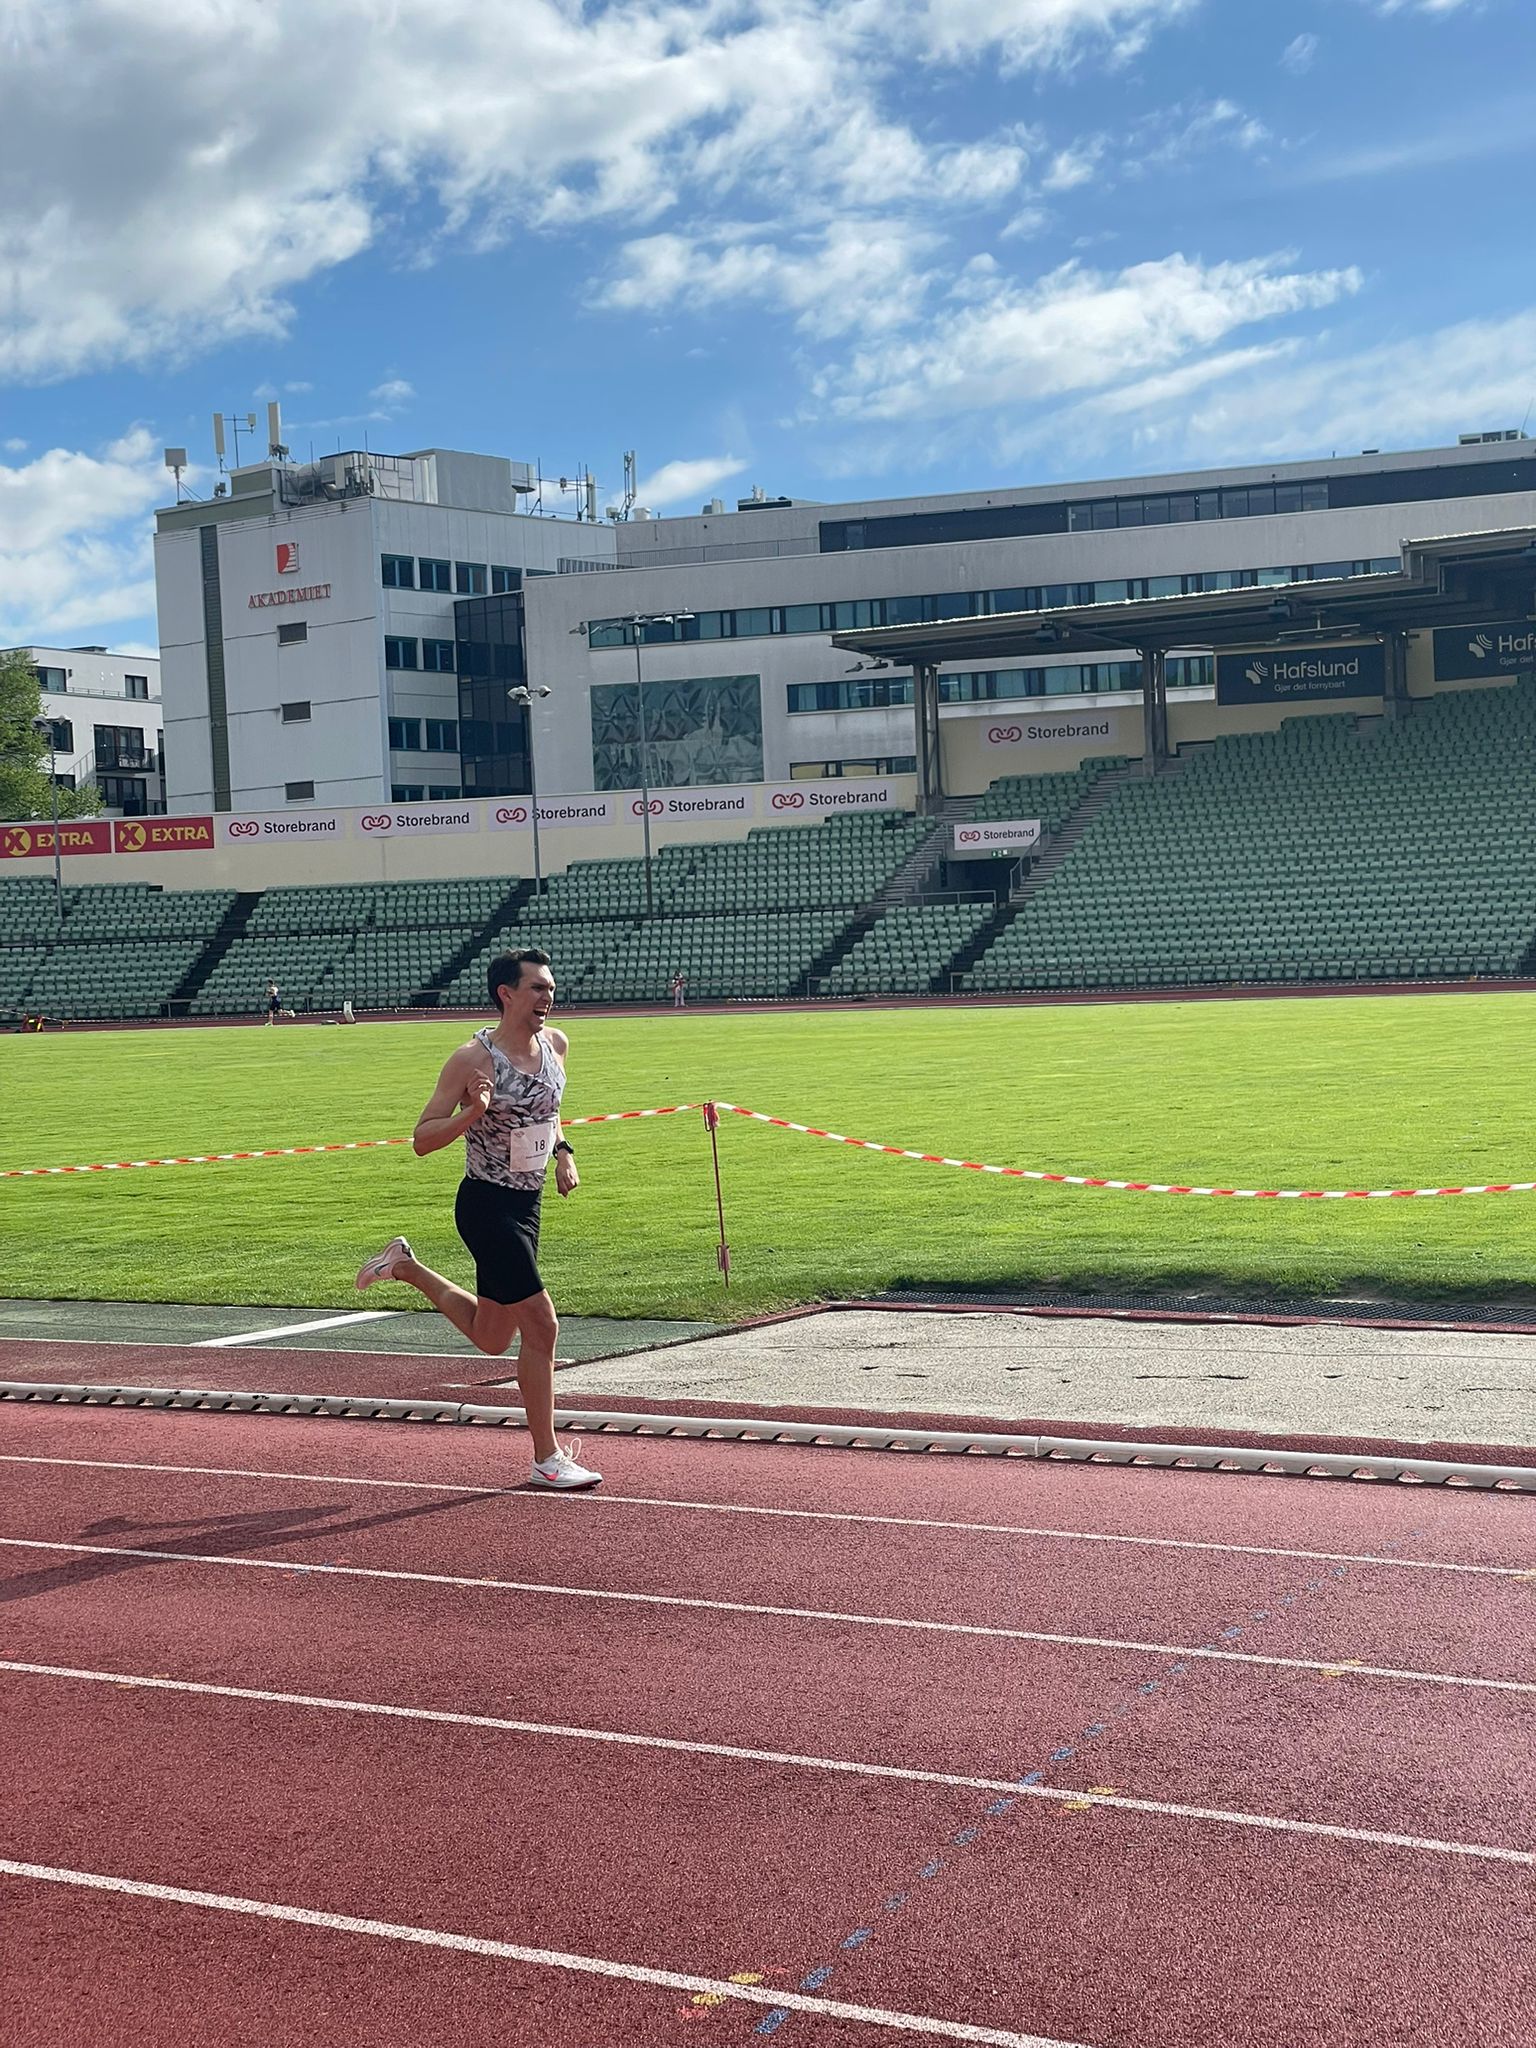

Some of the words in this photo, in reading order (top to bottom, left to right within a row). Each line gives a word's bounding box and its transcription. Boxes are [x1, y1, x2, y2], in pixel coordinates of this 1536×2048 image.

[248, 583, 331, 608] AKADEMIET
[1499, 633, 1536, 652] Haf
[1273, 658, 1359, 679] Hafslund
[1293, 682, 1307, 691] det
[1027, 722, 1109, 739] Storebrand
[668, 797, 745, 813] Storebrand
[809, 790, 887, 806] Storebrand
[397, 812, 470, 827] Storebrand
[532, 804, 606, 820] Storebrand
[152, 825, 209, 842] EXTRA
[264, 819, 336, 834] Storebrand
[983, 828, 1035, 840] Storebrand
[37, 831, 94, 848] EXTRA
[535, 1139, 545, 1151] 18
